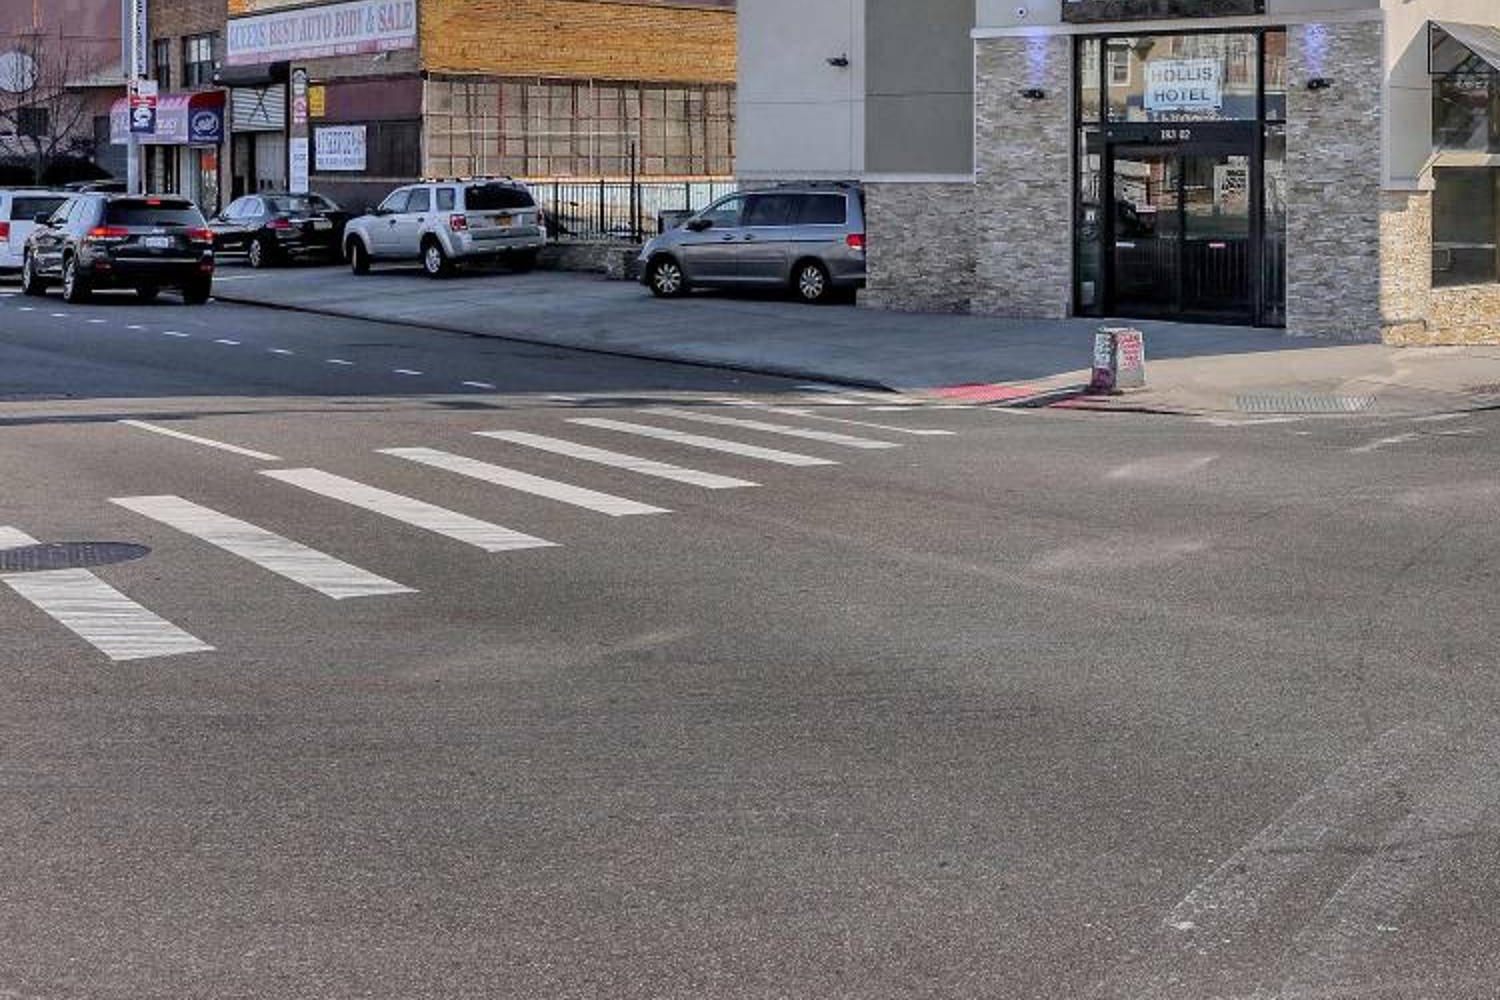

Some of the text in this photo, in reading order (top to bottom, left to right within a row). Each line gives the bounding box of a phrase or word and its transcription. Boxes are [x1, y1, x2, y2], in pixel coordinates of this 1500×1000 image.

[300, 12, 331, 42] AUTO
[1151, 66, 1212, 82] HOLLIS
[1154, 88, 1211, 102] HOTEL
